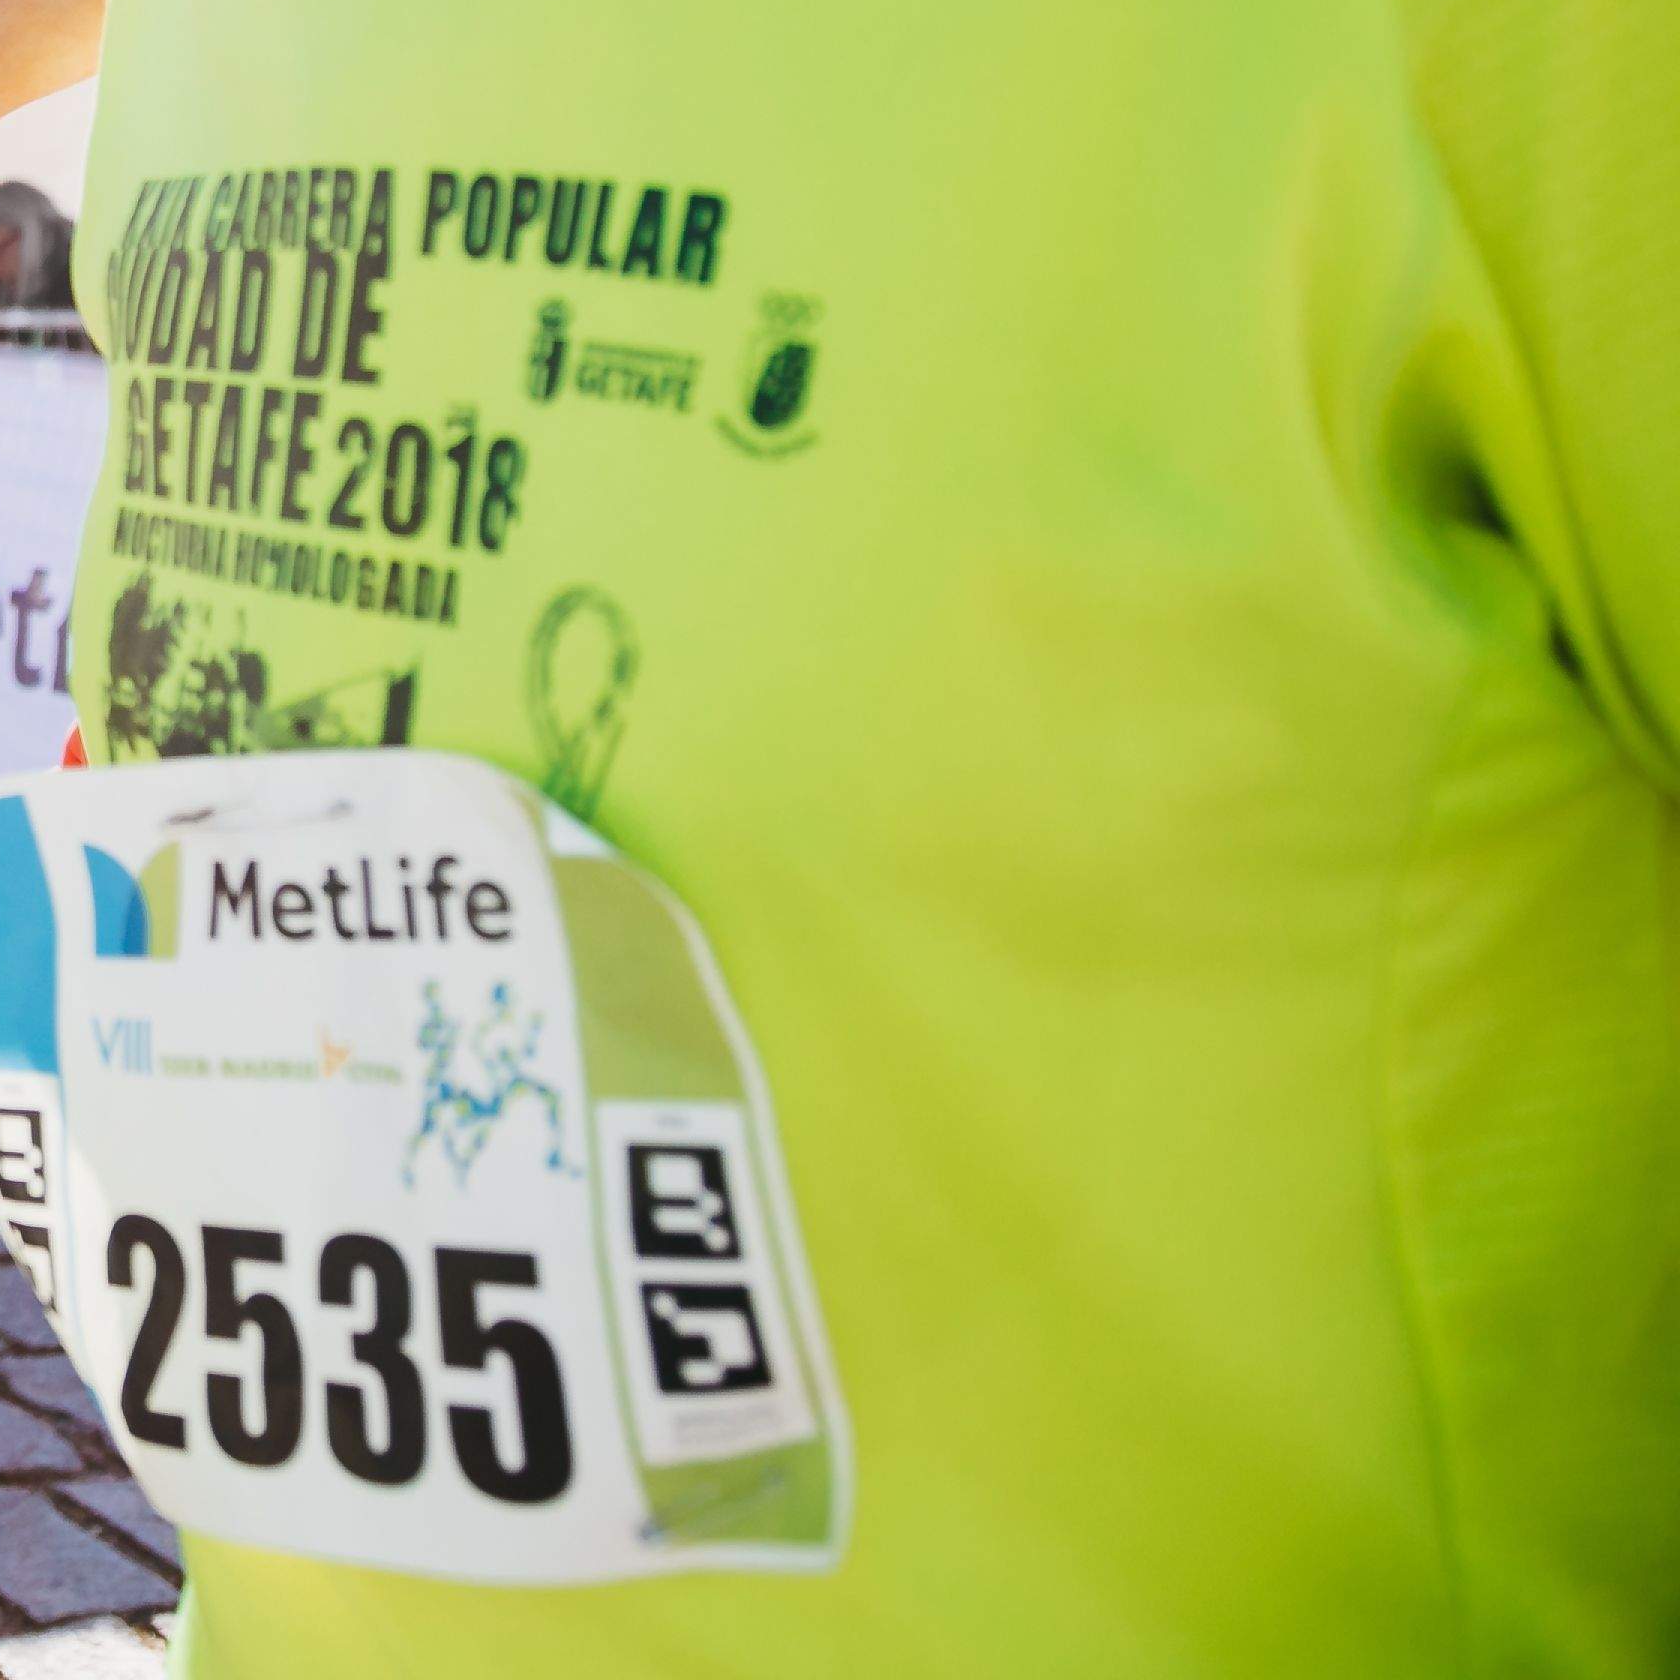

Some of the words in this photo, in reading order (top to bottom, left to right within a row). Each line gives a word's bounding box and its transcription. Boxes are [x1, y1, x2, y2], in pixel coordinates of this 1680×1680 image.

[420, 170, 726, 285] POPULAR
[292, 246, 392, 386] DE
[122, 376, 324, 524] GETAFE
[325, 416, 526, 554] 2018
[207, 853, 514, 943] MetLife
[107, 1213, 575, 1505] 2535
